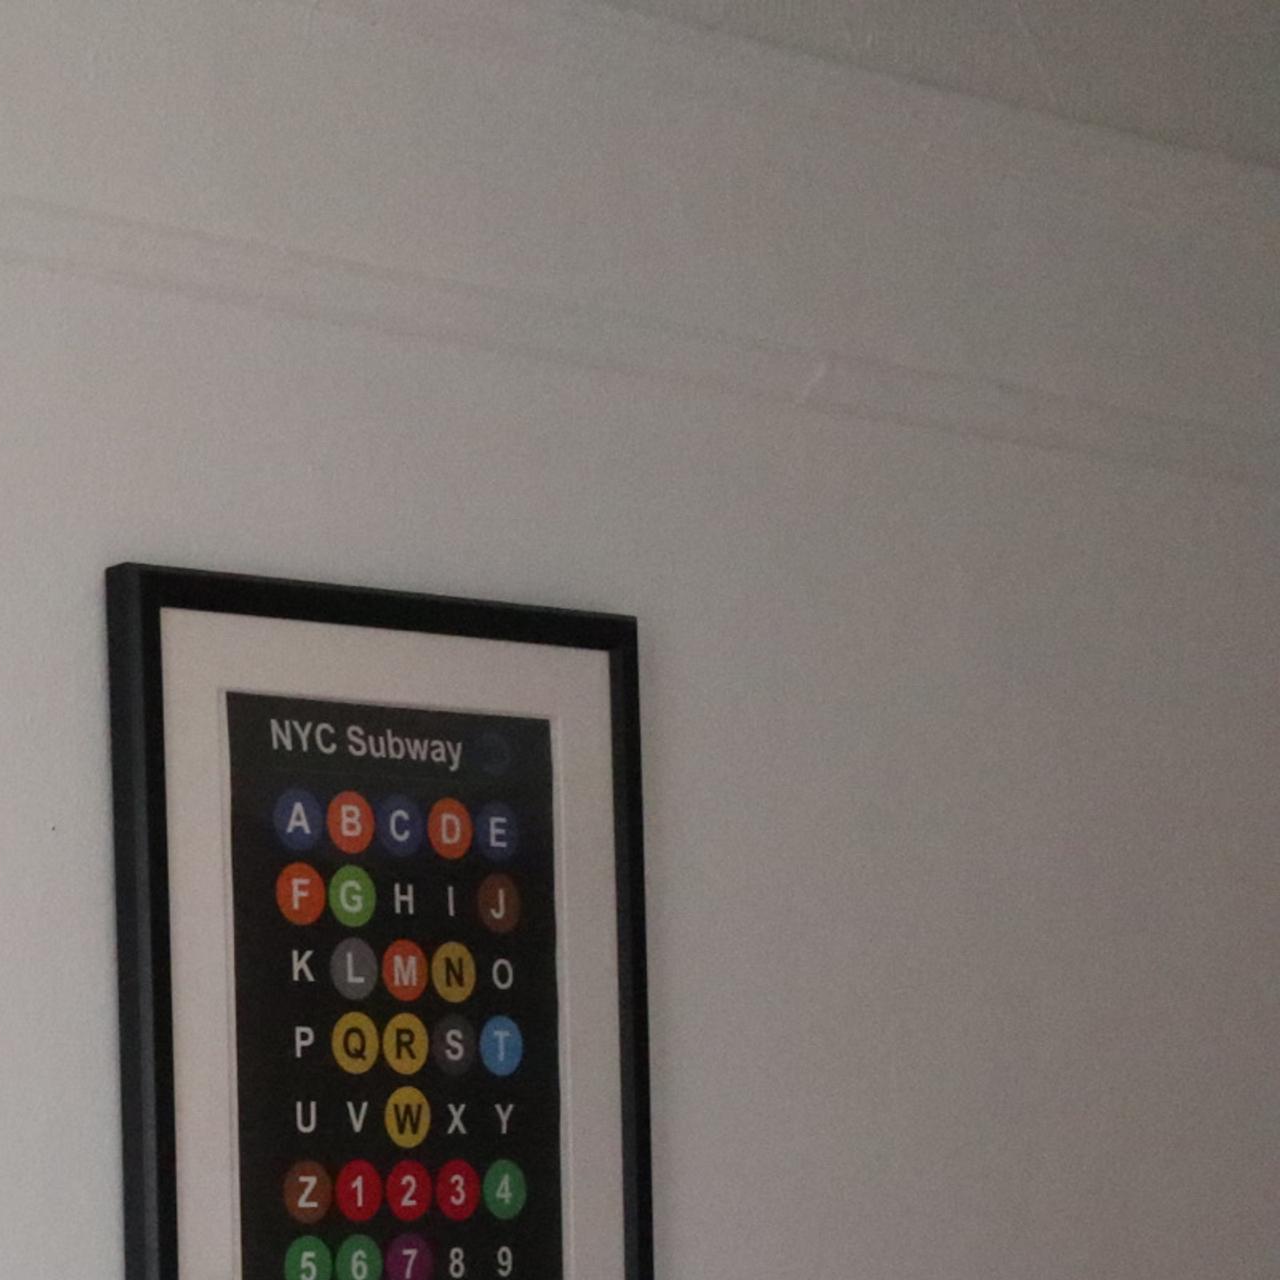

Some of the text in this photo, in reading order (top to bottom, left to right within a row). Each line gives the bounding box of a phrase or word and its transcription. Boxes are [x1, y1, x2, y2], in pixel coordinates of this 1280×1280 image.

[270, 718, 462, 772] NYC Subway
[287, 802, 507, 847] A B C D E
[292, 878, 505, 919] F G H I J
[292, 950, 513, 989] K L M N O
[296, 1026, 512, 1061] P Q R S T
[296, 1101, 514, 1135] U V W X Y
[298, 1174, 512, 1208] Z 1 2 3 4
[402, 1248, 418, 1279] 7
[450, 1248, 464, 1278] 8
[498, 1246, 512, 1277] 9
